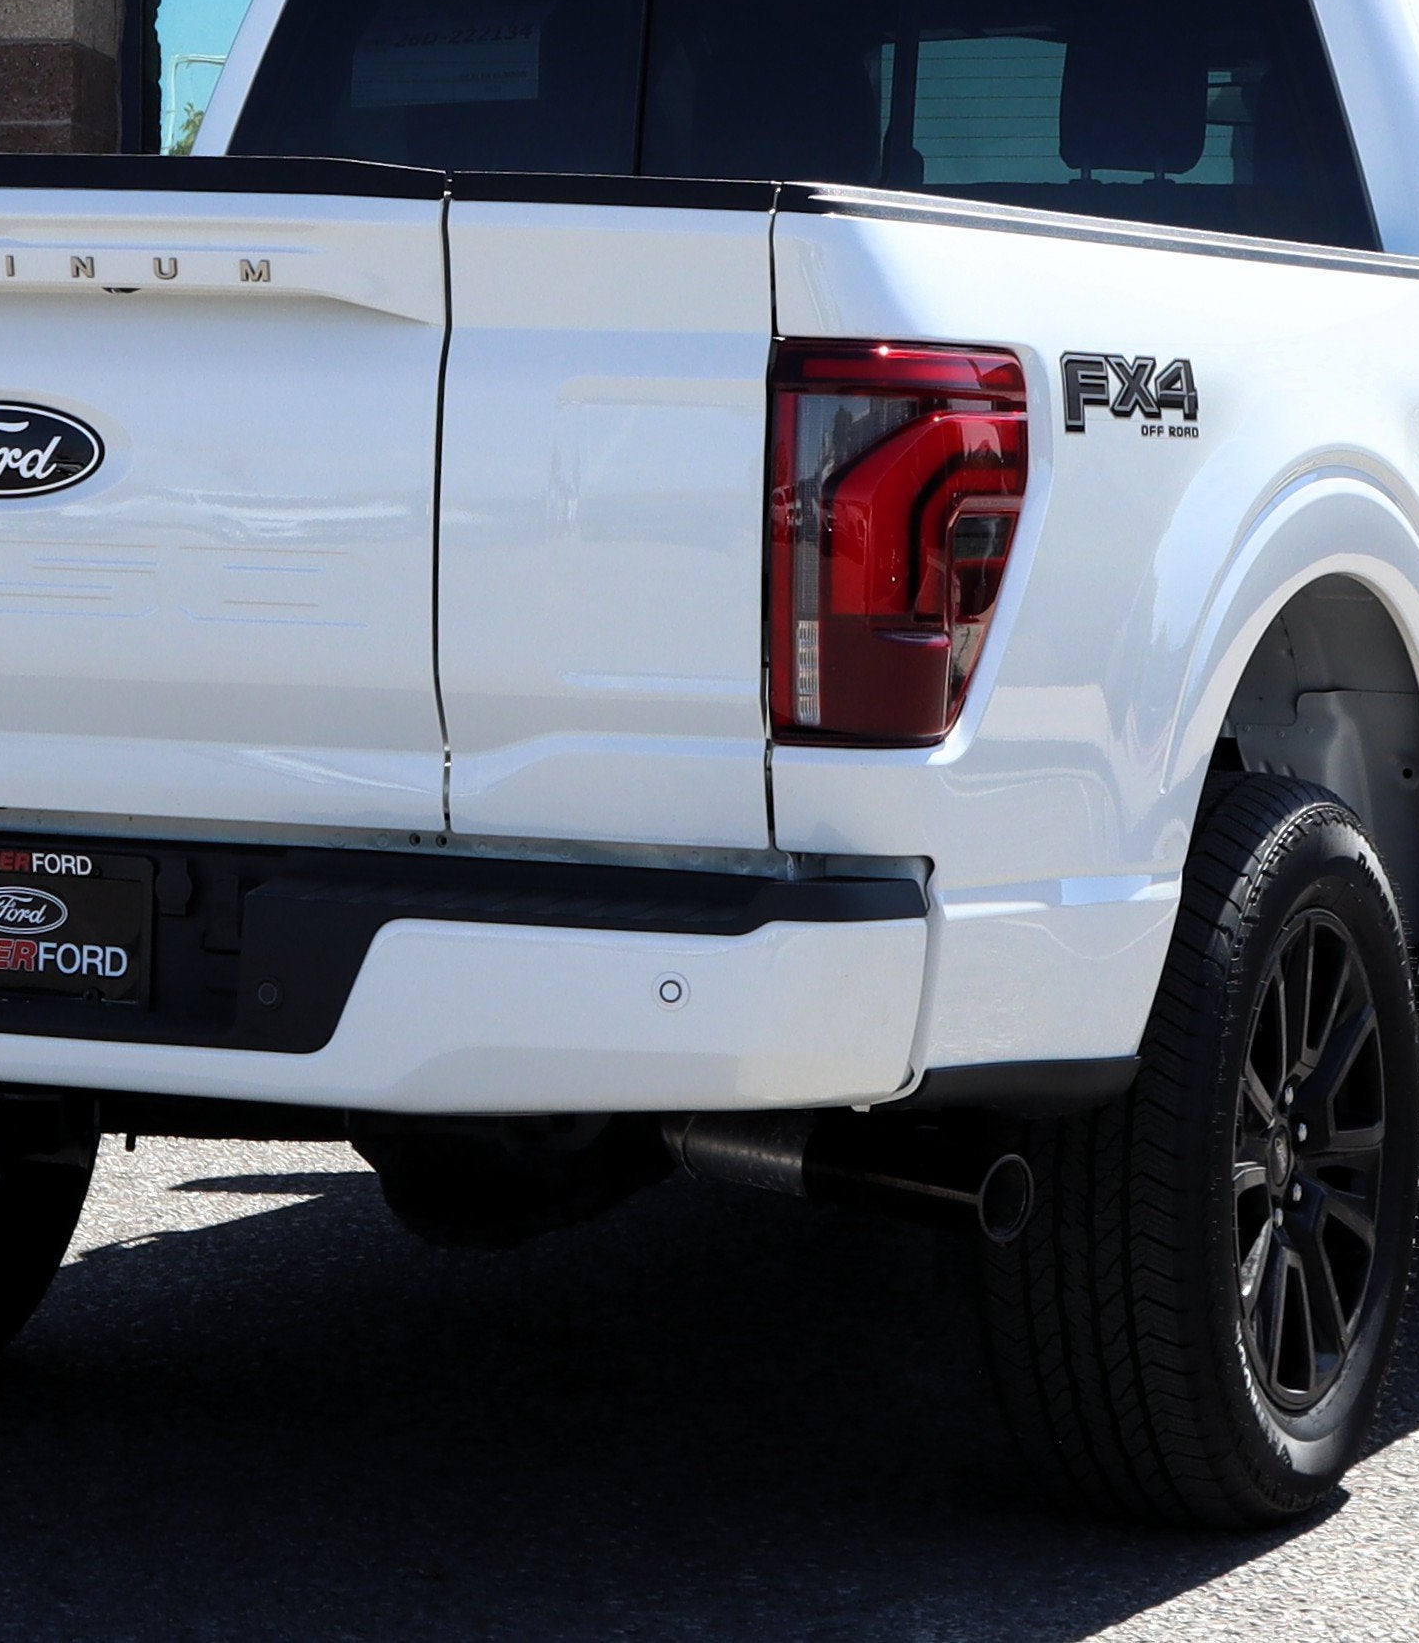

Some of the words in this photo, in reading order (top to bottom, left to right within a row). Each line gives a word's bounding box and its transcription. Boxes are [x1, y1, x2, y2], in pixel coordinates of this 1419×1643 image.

[1060, 350, 1199, 433] FX4
[1141, 424, 1165, 437] OFF
[1168, 425, 1199, 438] ROAD
